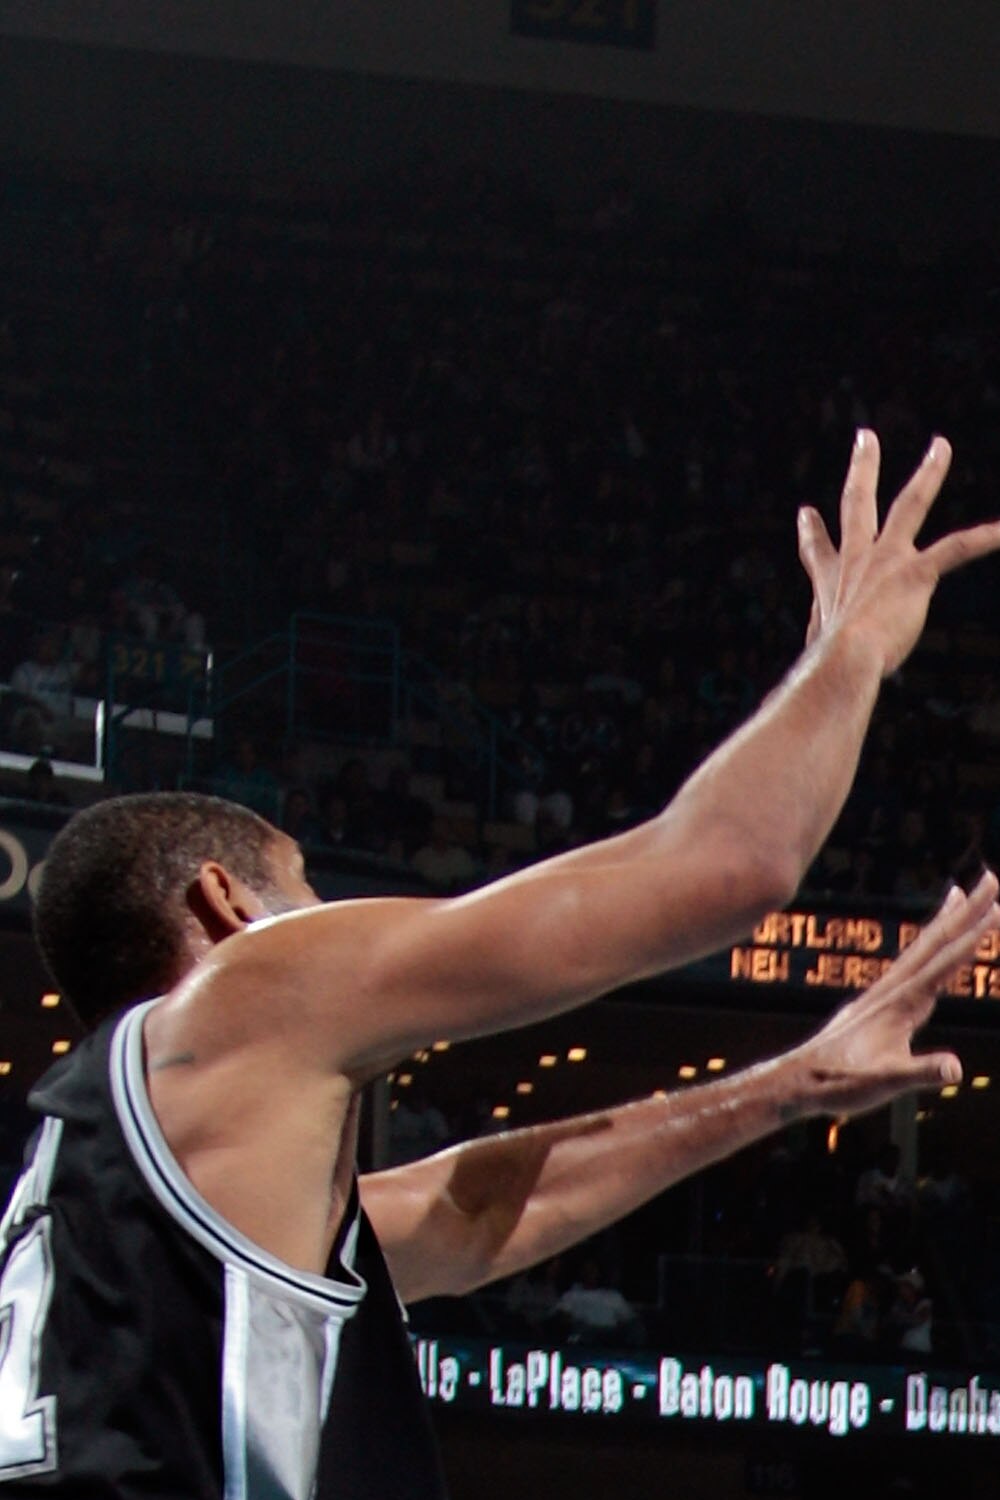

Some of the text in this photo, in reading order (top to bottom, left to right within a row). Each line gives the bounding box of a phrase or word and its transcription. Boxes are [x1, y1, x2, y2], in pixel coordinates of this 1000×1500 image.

[752, 911, 883, 953] ORTLAND
[730, 946, 789, 982] NEW
[804, 951, 893, 990] JERS
[490, 1347, 624, 1414] LaPlace
[659, 1357, 754, 1421] Baton
[767, 1364, 870, 1436] Rouge
